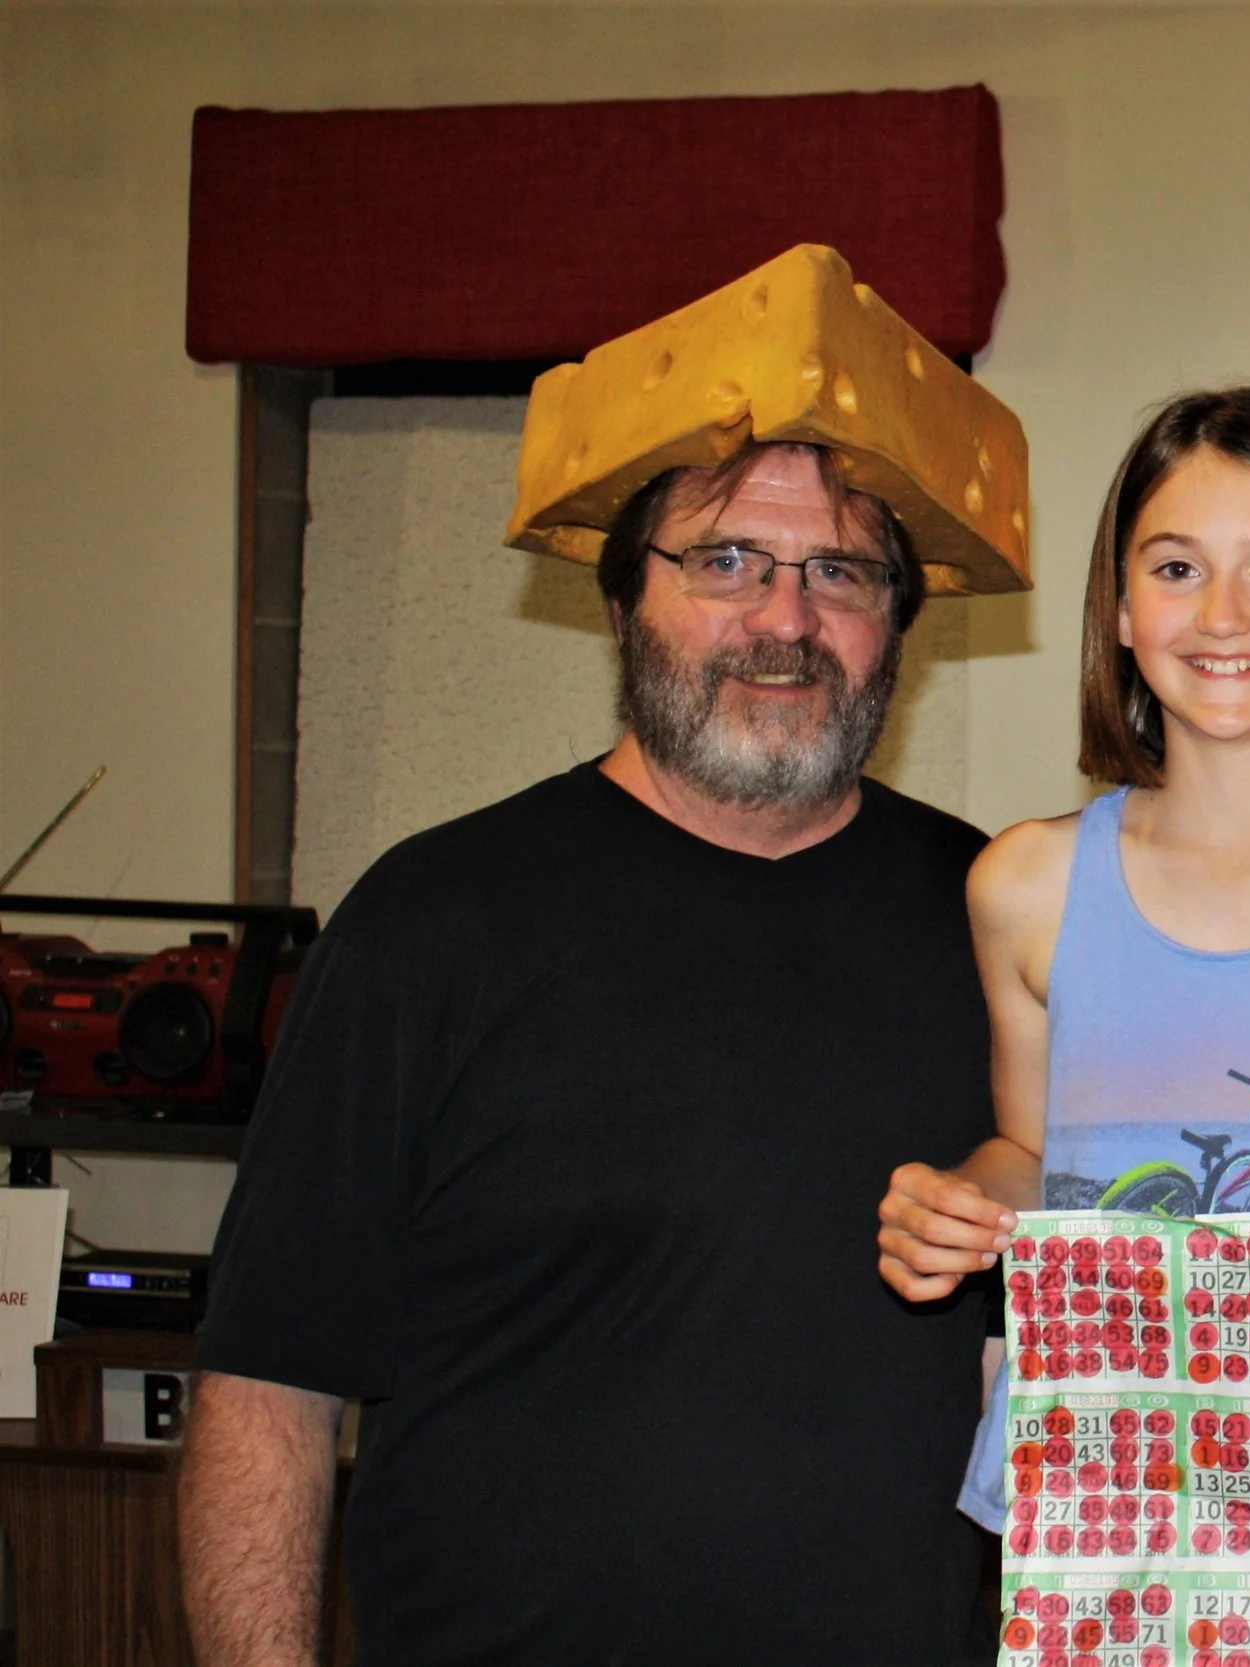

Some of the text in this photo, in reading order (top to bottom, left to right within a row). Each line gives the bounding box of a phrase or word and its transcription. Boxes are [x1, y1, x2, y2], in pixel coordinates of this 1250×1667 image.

[1190, 1272, 1216, 1290] 10
[1222, 1271, 1247, 1290] 27
[1224, 1327, 1248, 1347] 19
[1015, 1420, 1040, 1438] 10
[1077, 1416, 1103, 1435] 31
[1077, 1444, 1105, 1462] 43
[1201, 1447, 1209, 1465] 1
[1195, 1473, 1219, 1492] 13
[1045, 1502, 1071, 1520] 27
[1196, 1500, 1221, 1519] 10
[1201, 1530, 1213, 1549] 7
[1075, 1597, 1103, 1616] 43
[1194, 1595, 1219, 1615] 12
[1143, 1624, 1167, 1643] 71
